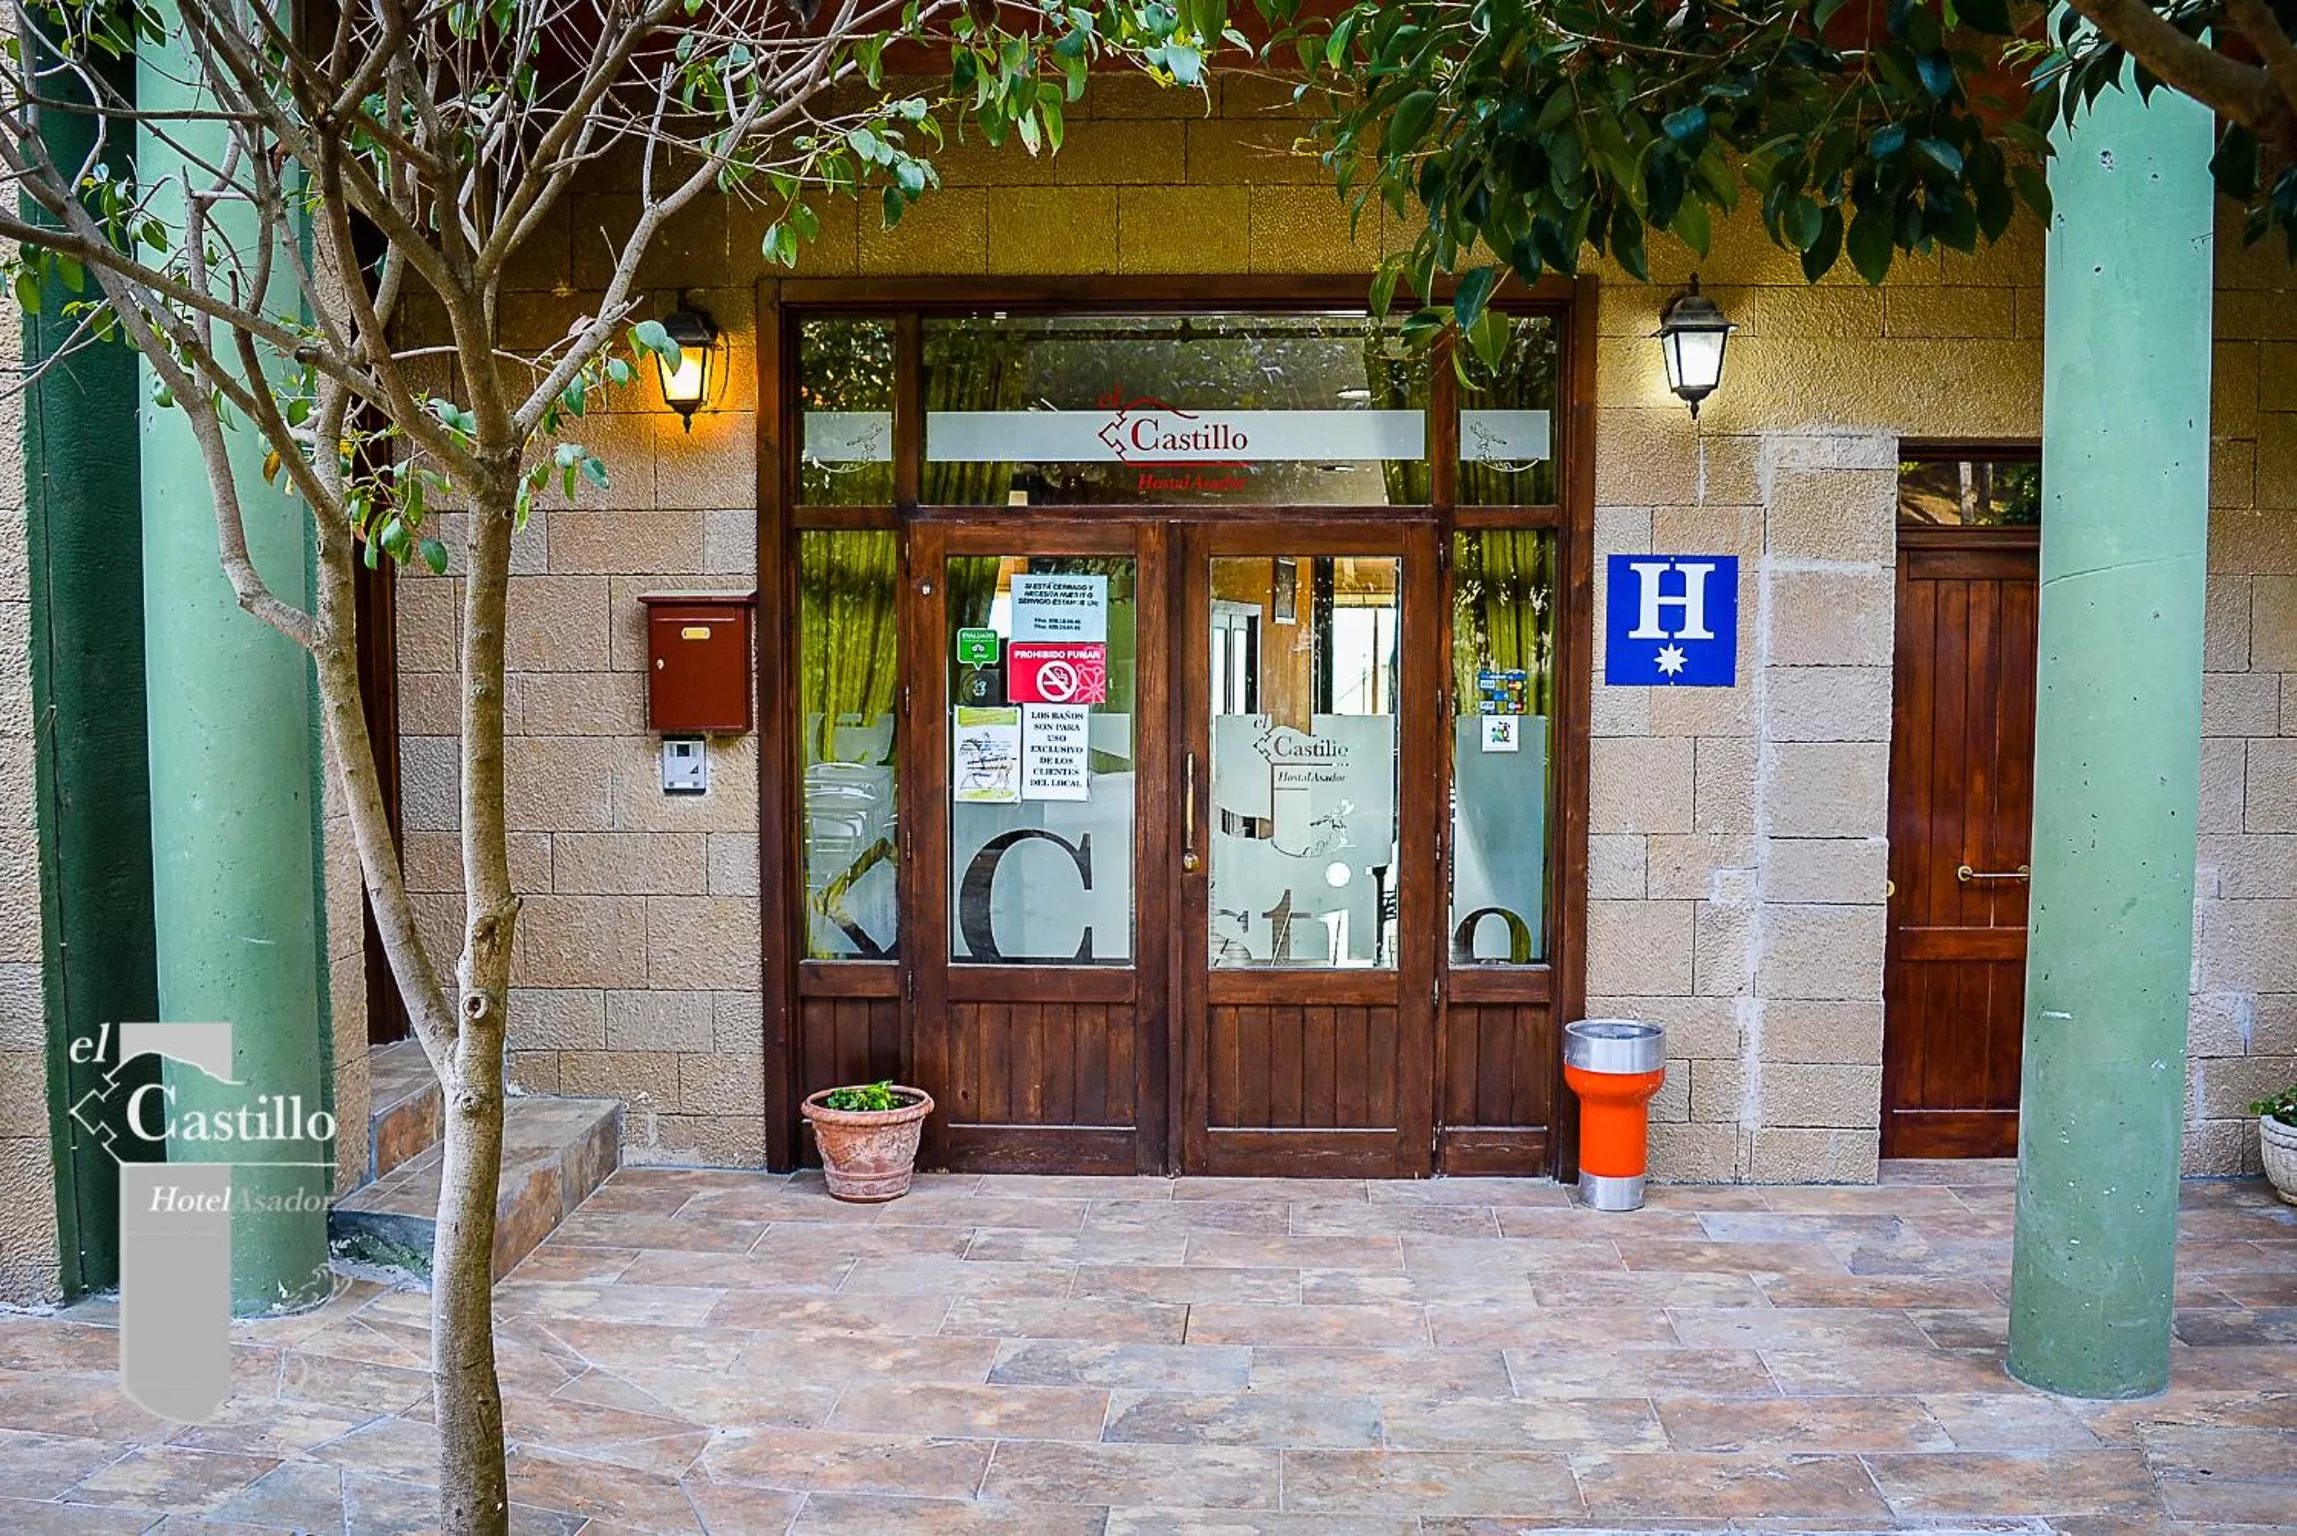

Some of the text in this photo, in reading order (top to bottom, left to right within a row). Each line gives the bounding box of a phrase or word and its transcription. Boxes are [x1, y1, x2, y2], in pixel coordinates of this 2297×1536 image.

[1131, 418, 1248, 451] Castillo
[1628, 562, 1716, 640] H
[1014, 651, 1101, 659] PROHIBIDO FUMAR
[1031, 710, 1084, 720] LOS BAÑOS
[1033, 723, 1081, 731] SON PARA
[1047, 734, 1067, 742] USO
[1030, 745, 1084, 754] EXCLUSIVO
[1273, 735, 1349, 758] Castillo
[1040, 756, 1074, 764] DE LOS
[1033, 768, 1080, 776] CLIENTES
[1030, 779, 1081, 787] DEL LOCAL
